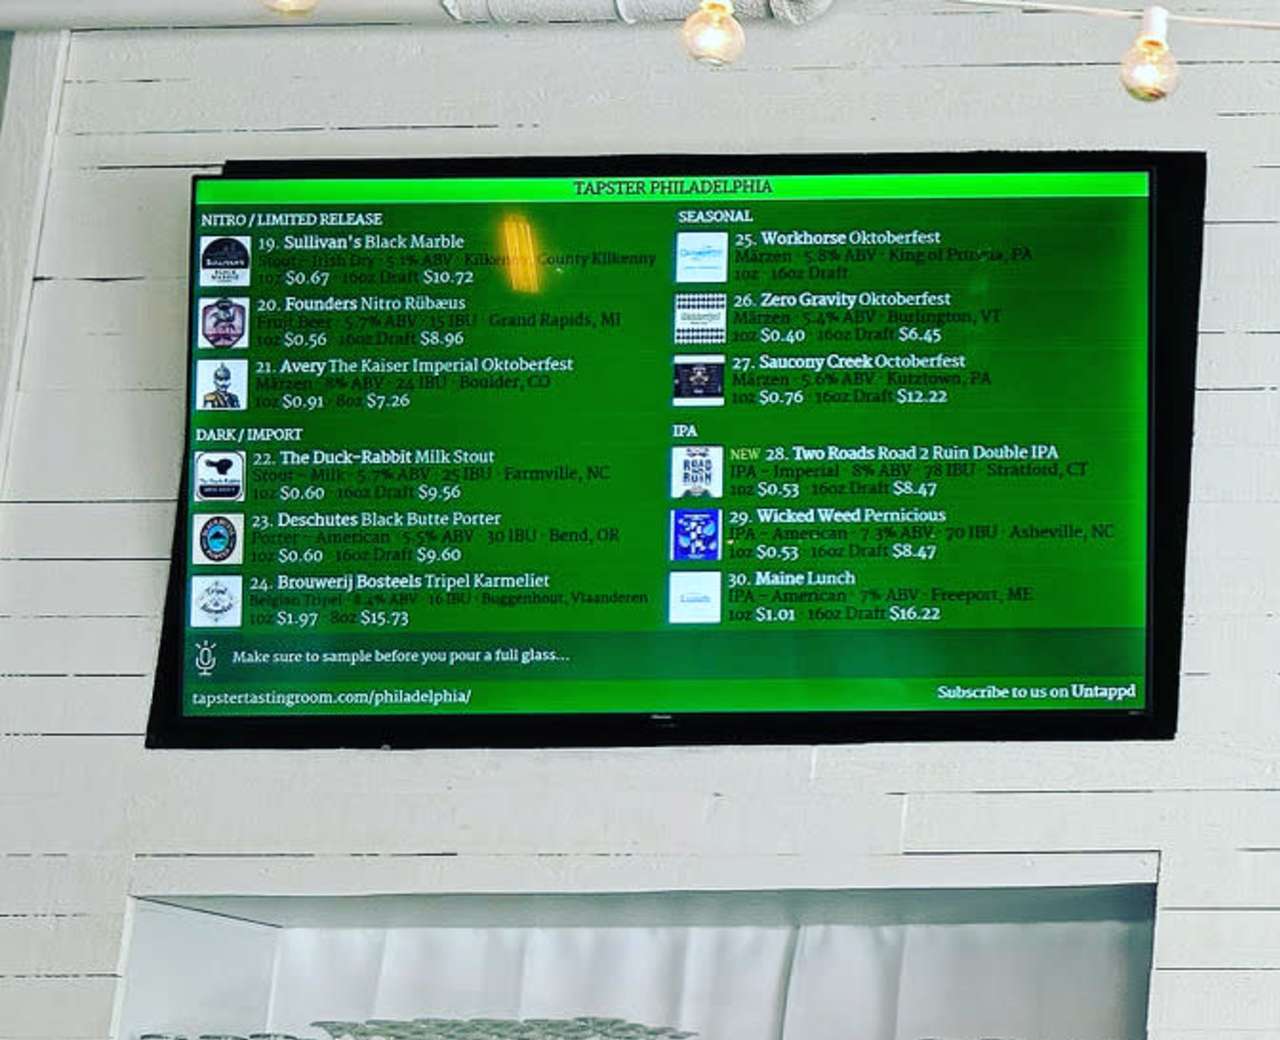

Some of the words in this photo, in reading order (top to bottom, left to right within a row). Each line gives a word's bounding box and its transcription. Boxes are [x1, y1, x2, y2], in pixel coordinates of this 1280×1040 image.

[574, 181, 648, 195] TAPSTER
[650, 179, 772, 195] PHILADELPHIA
[201, 213, 247, 227] NITRO
[257, 212, 318, 226] LIMITED
[319, 212, 383, 226] RELEASE
[678, 209, 754, 224] SEASONAL
[259, 237, 280, 253] 19.
[283, 234, 362, 250] Sullivan's
[364, 234, 407, 249] Black
[409, 233, 465, 249] Marble
[735, 233, 757, 249] 25.
[760, 230, 847, 246] Workhorse
[848, 229, 941, 245] Oktoberfest
[423, 269, 474, 286] $10.72
[898, 326, 942, 343] $6.45
[896, 388, 948, 404] $12.22
[195, 428, 237, 442] DARK
[247, 427, 304, 441] IMPORT
[673, 424, 698, 438] IPA
[253, 452, 276, 466] 22.
[279, 450, 310, 465] The
[312, 449, 412, 465] Duck-Rabbit
[414, 449, 451, 464] Milk
[453, 449, 494, 464] Stout
[731, 447, 760, 461] NEW
[418, 483, 461, 502] $9.56
[728, 573, 751, 588] 30.
[755, 570, 805, 586] Maine
[807, 570, 856, 586] Lunch
[192, 689, 472, 708] tapstertastingroom.com/philadelphia/
[937, 685, 1010, 699] Subscribe
[1011, 687, 1028, 698] to
[1030, 687, 1048, 698] us
[1049, 687, 1069, 698] on
[1070, 683, 1137, 701] Untappd
